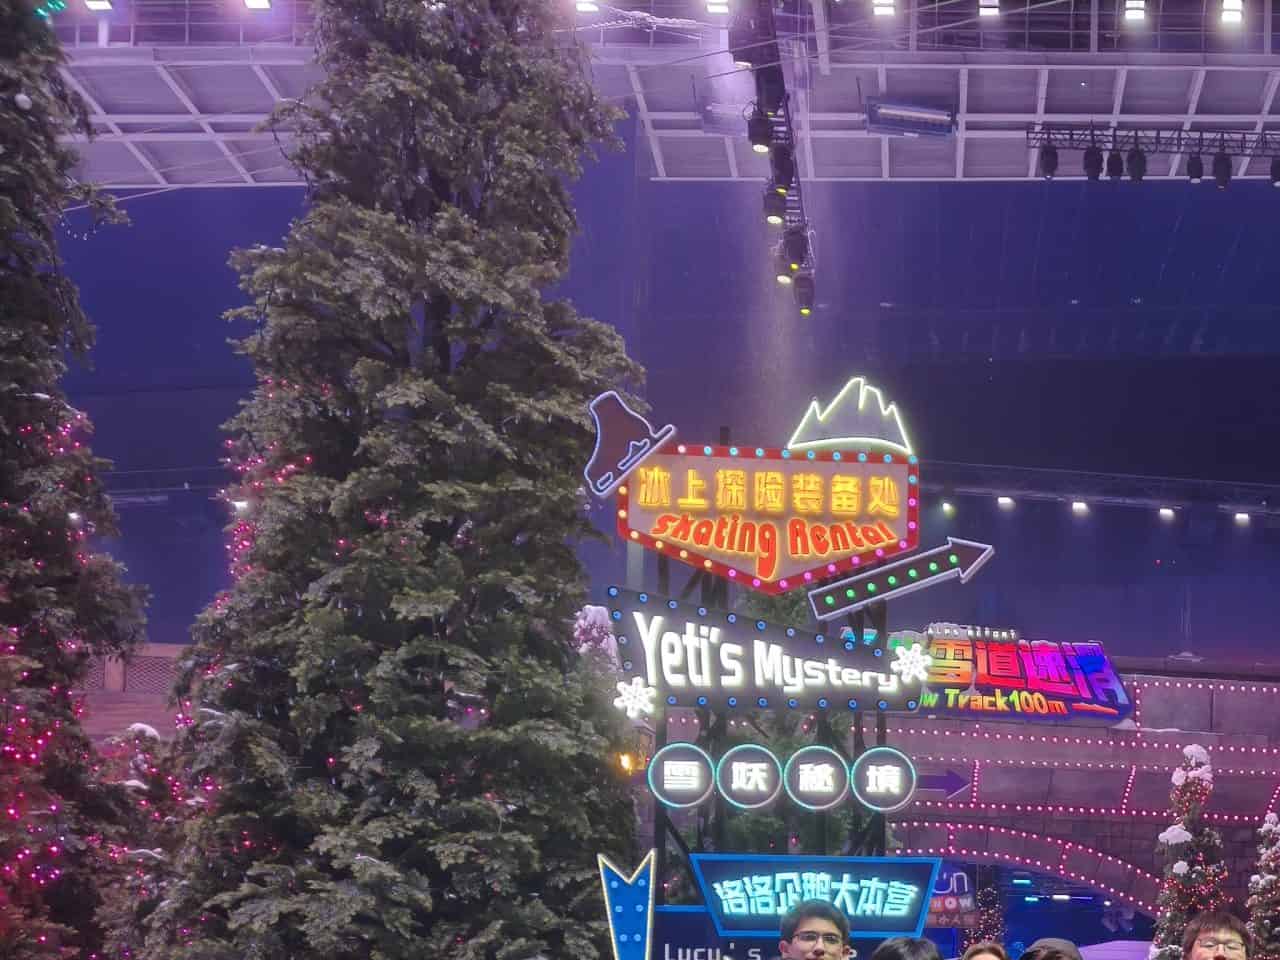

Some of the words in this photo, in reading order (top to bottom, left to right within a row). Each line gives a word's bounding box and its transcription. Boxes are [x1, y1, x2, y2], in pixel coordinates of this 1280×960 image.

[639, 468, 900, 516] 冰上探险装备处
[788, 517, 898, 555] Rental
[632, 611, 742, 687] Yeti's
[753, 640, 899, 693] Mystery
[663, 761, 902, 793] 雪妖秘境
